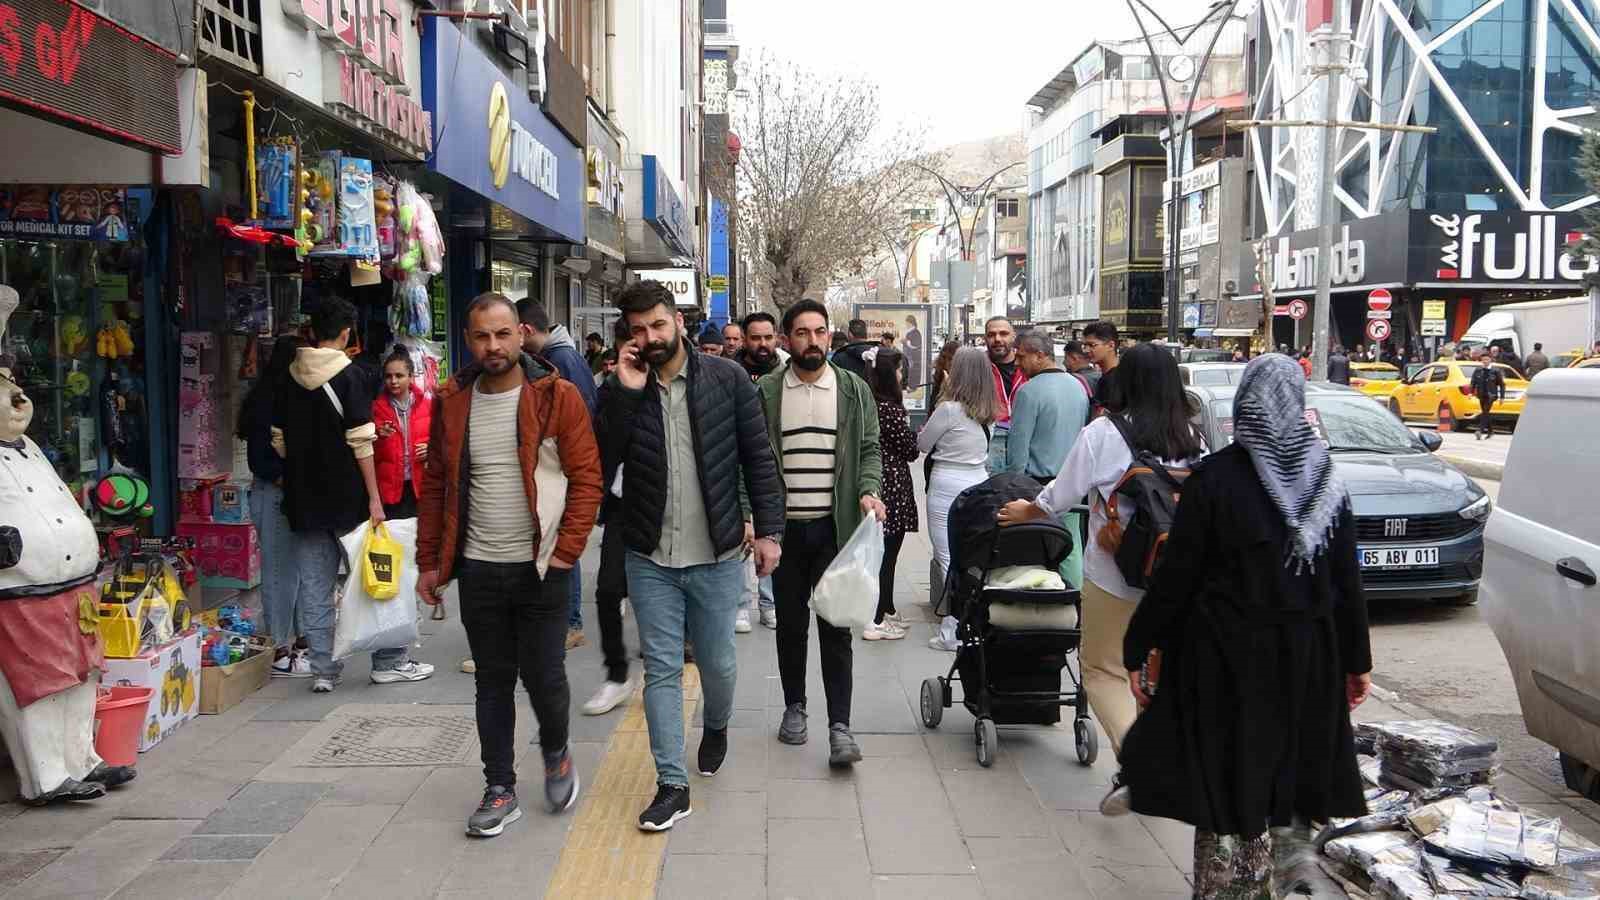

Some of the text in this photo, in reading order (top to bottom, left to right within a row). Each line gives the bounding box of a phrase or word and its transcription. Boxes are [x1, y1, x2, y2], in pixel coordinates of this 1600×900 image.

[16, 221, 56, 233] MEDICAL
[60, 223, 73, 235] KIT
[74, 224, 91, 236] SET
[660, 281, 688, 294] OLD
[1384, 518, 1408, 537] FIAT
[1364, 549, 1437, 565] 65 ABY 011
